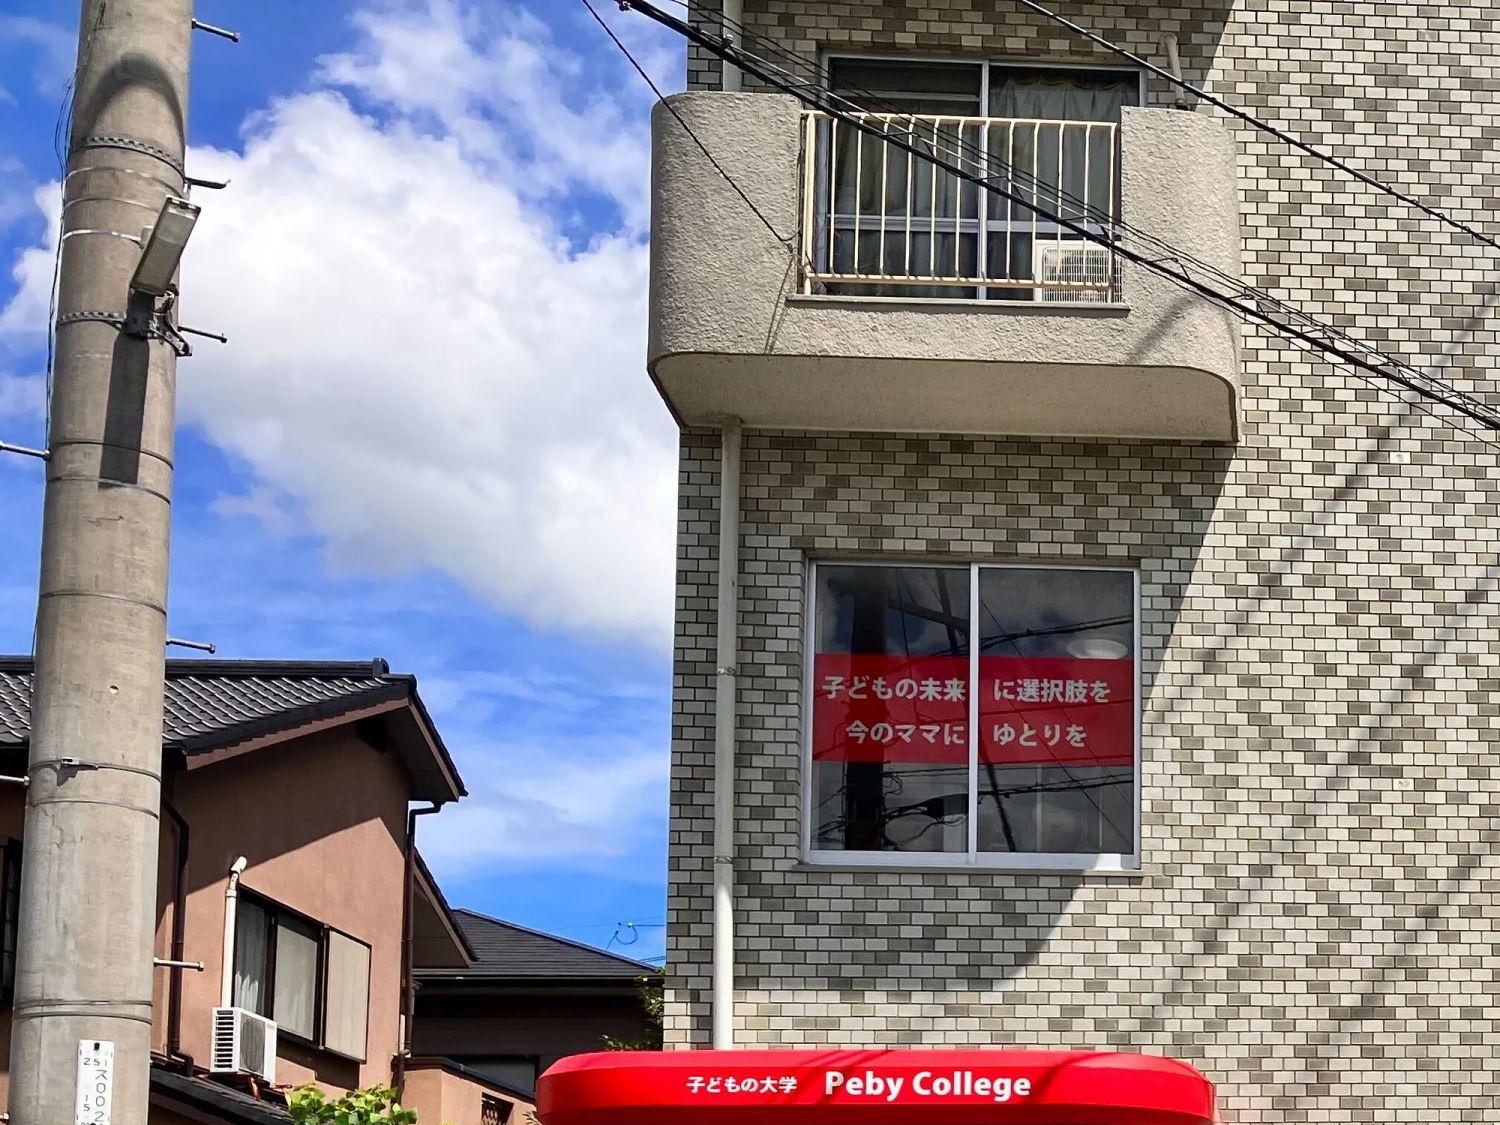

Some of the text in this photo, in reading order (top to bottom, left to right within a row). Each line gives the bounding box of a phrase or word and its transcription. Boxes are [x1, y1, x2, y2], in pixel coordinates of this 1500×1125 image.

[822, 676, 1111, 703] 子どもの未来 に選択肢を
[846, 720, 1087, 747] 今のママに ゆとりを
[686, 1071, 1032, 1101] 子どもの大学 Peby College
